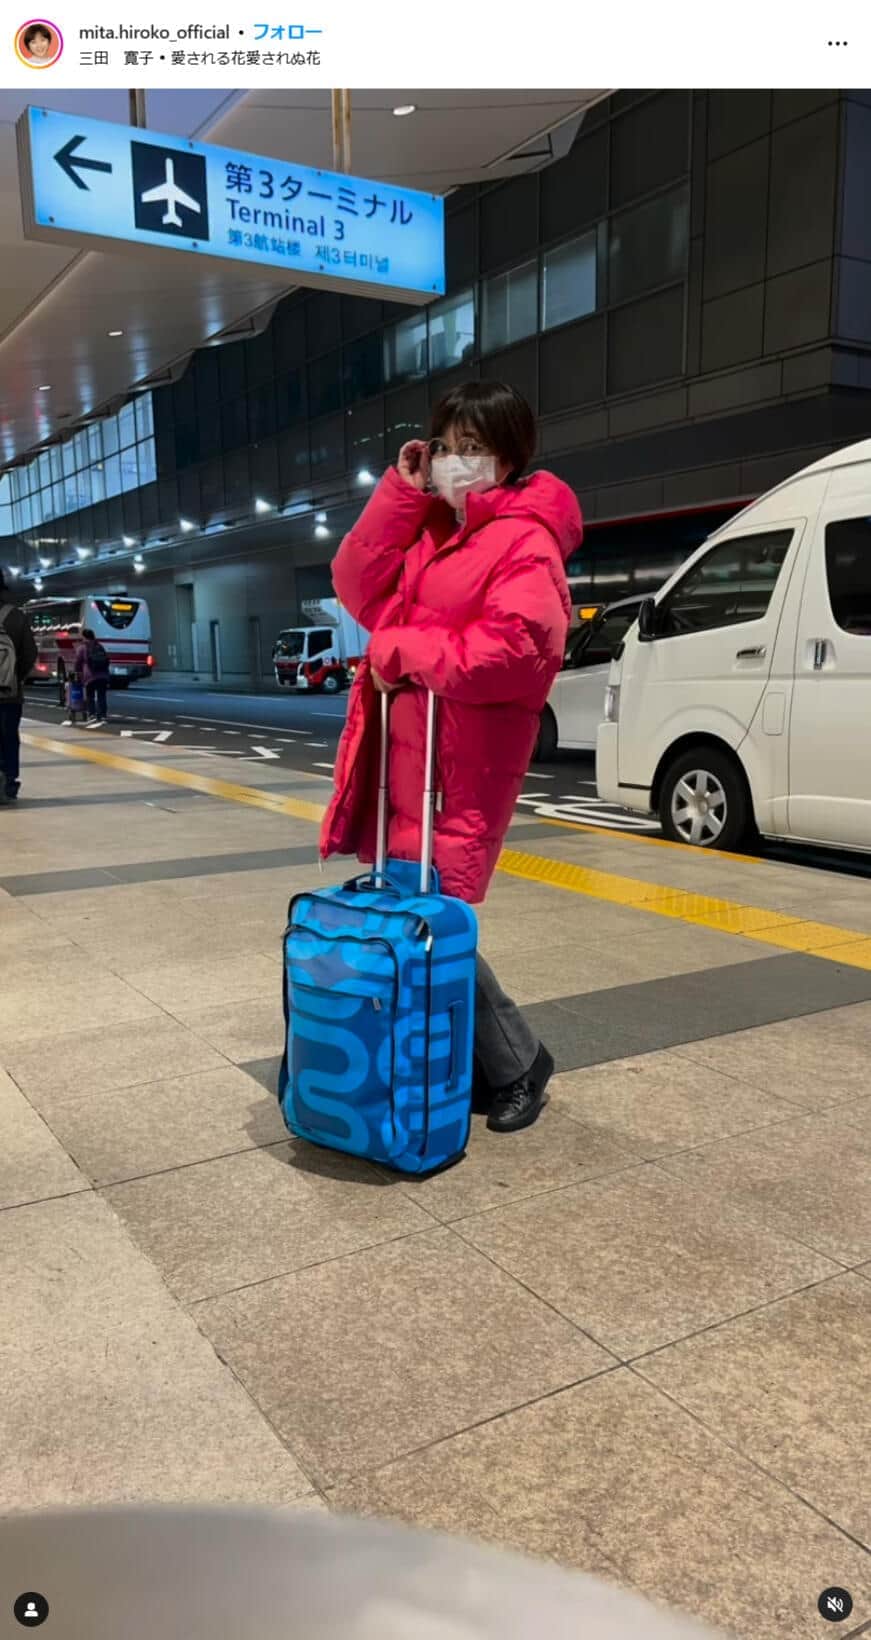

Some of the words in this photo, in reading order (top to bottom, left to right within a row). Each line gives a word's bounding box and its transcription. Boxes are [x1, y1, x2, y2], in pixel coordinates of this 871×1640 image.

[225, 161, 413, 225] 第3ターミナル
[226, 198, 325, 237] Terminal
[334, 219, 345, 241] 3
[315, 245, 390, 273] 제3터미널
